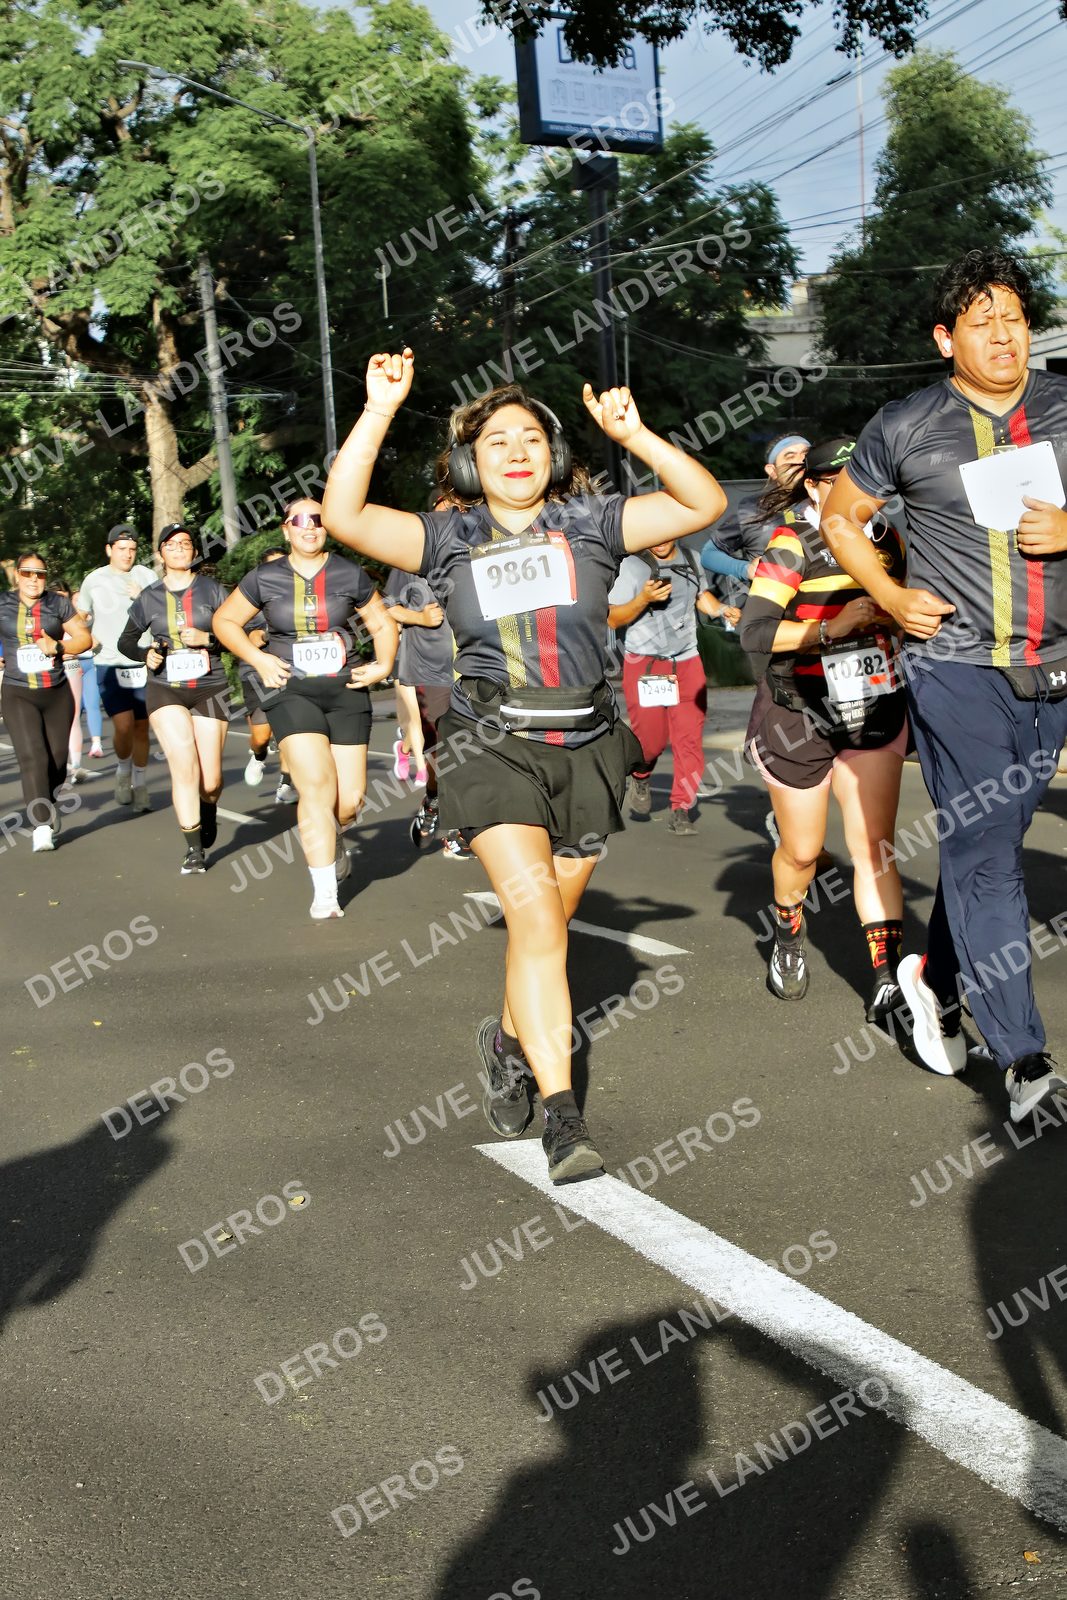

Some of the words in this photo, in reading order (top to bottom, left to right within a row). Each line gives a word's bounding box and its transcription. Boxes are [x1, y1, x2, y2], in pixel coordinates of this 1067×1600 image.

[487, 554, 551, 589] 9861
[298, 646, 338, 662] 10570
[827, 653, 885, 680] 10282
[642, 684, 673, 695] 12494
